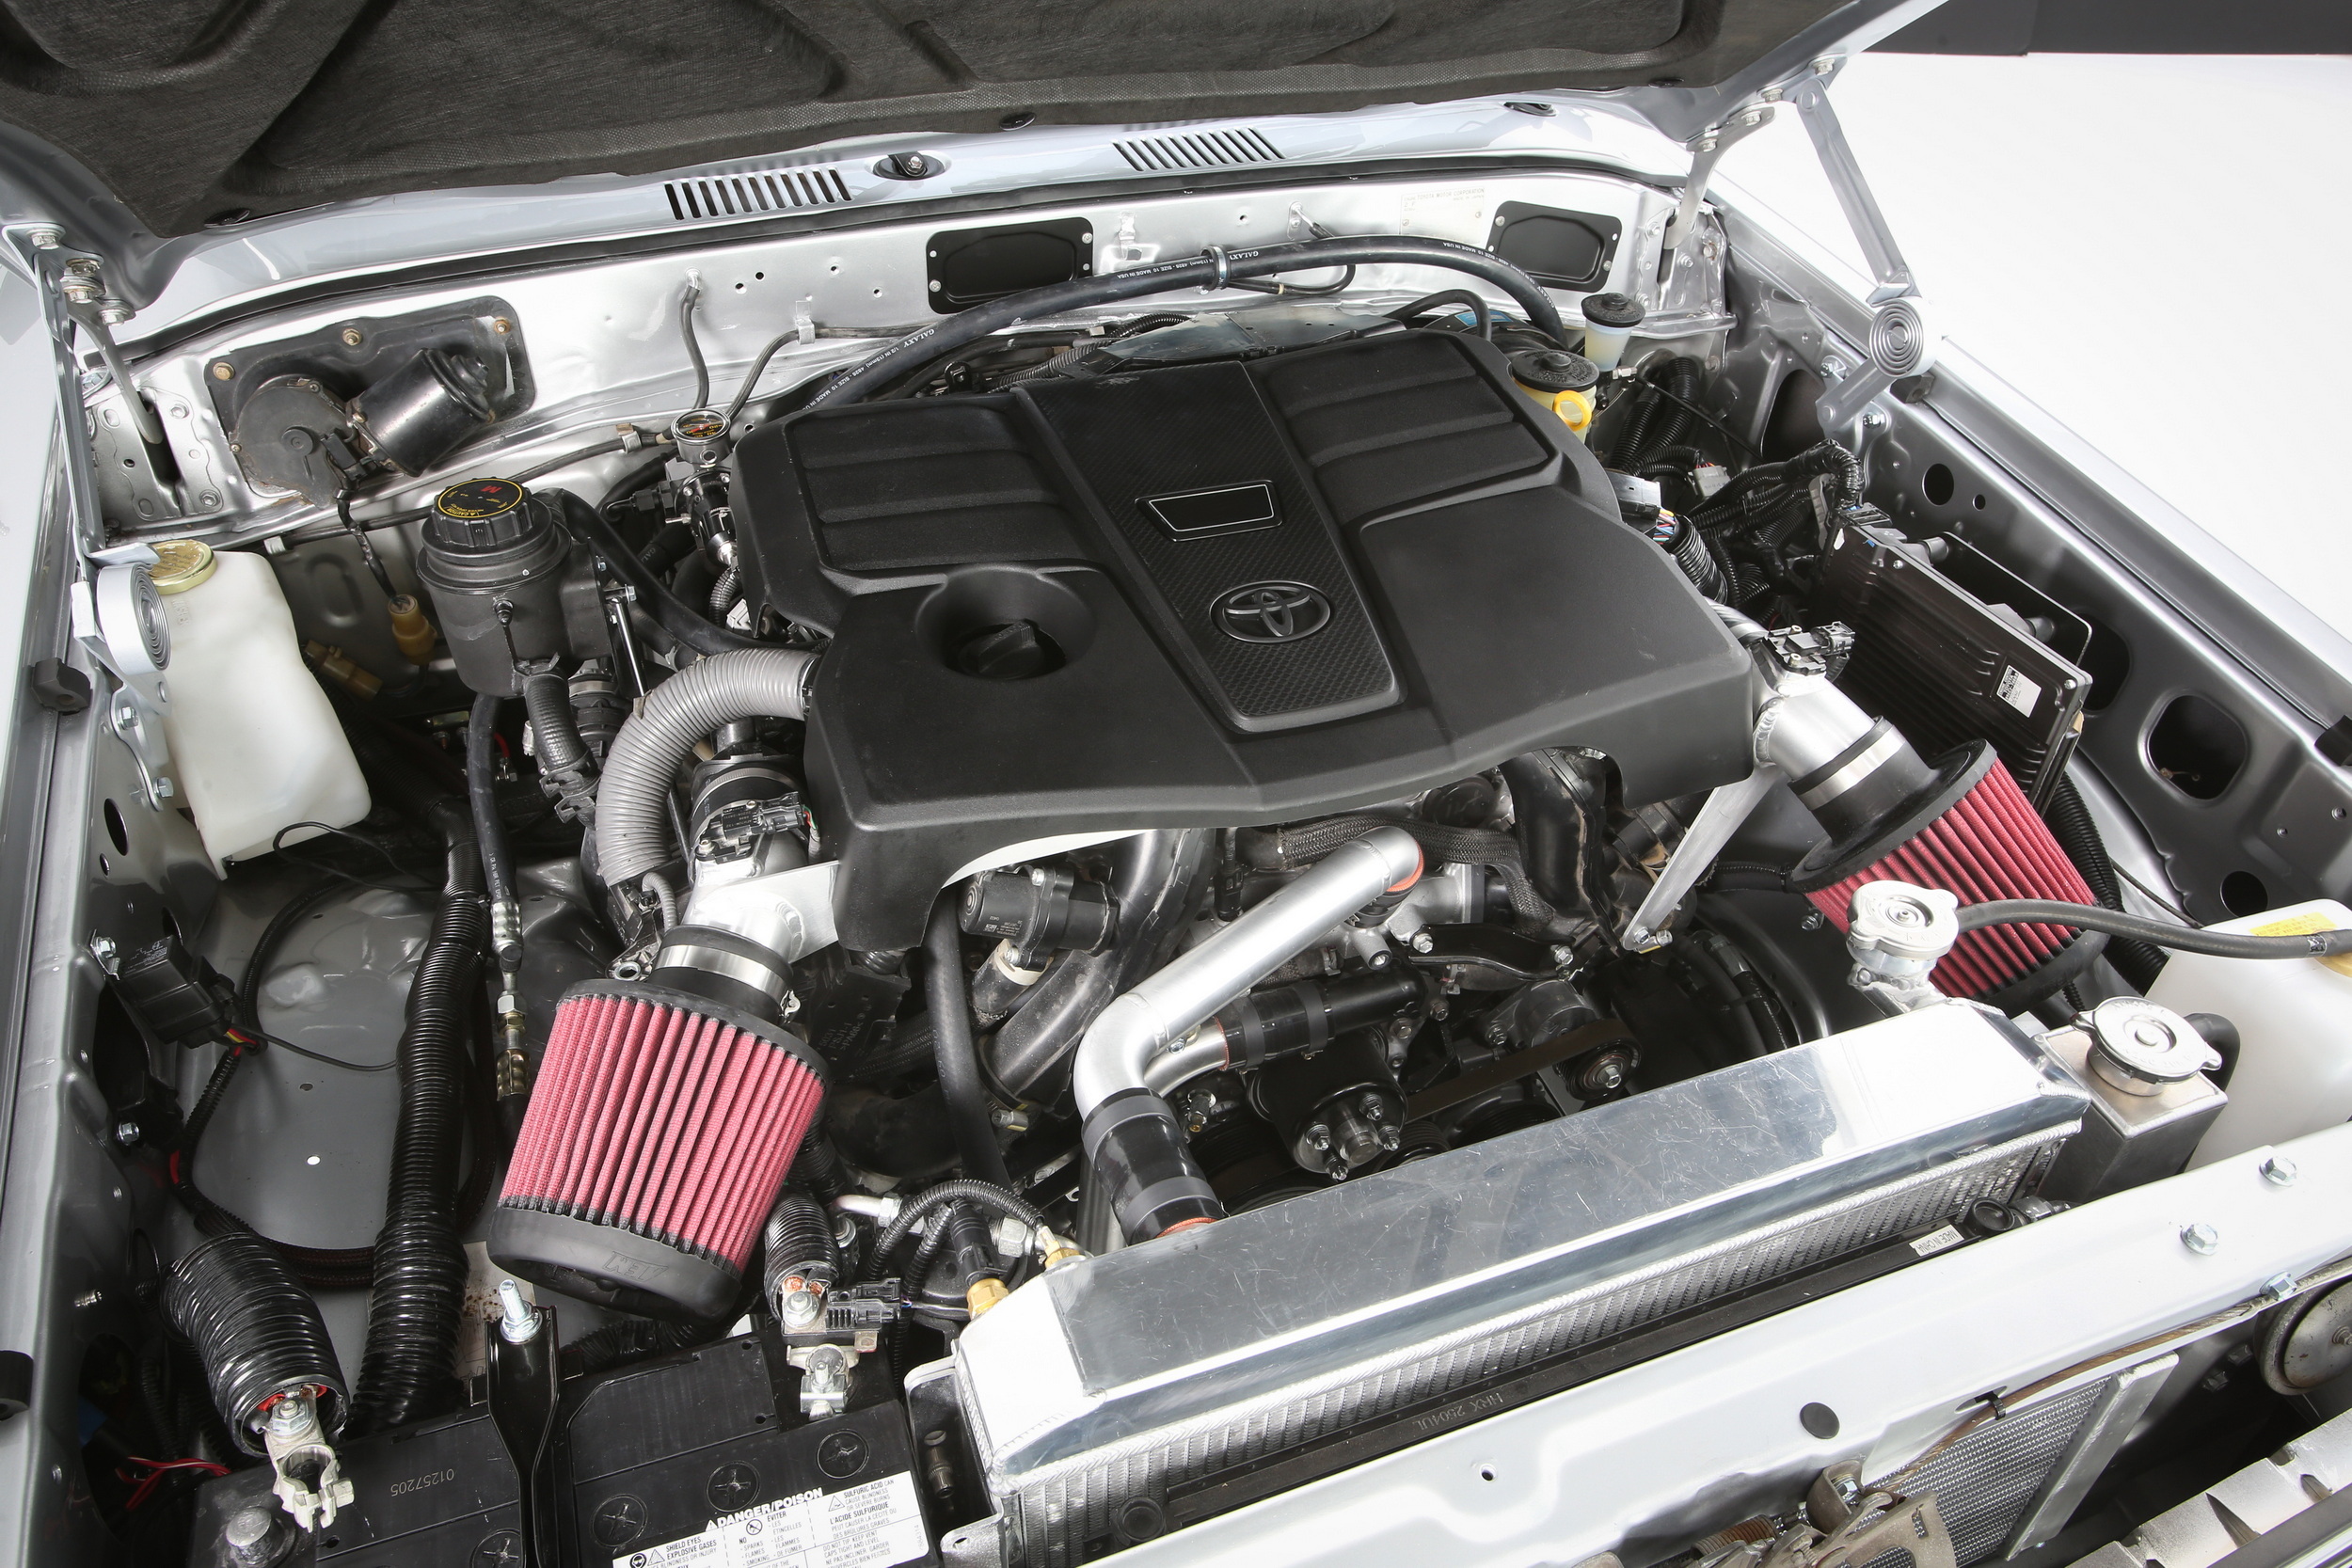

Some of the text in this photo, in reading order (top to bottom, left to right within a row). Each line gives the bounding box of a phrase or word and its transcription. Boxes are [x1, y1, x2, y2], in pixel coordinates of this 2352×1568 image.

[1485, 251, 1496, 260] SIZE
[904, 329, 935, 348] GALAXY
[866, 354, 884, 369] (13mm)
[838, 376, 850, 386] SIZE
[817, 389, 831, 403] MADE
[1915, 1229, 1958, 1253] MADE IN CHINA
[1469, 1392, 1504, 1413] HRX
[390, 1468, 454, 1497] 01257205
[844, 1485, 869, 1498] SULFURIC
[870, 1481, 882, 1490] ACID
[862, 1488, 888, 1499] BLINDNESS
[717, 1487, 823, 1528] DANGER/POISON
[855, 1499, 872, 1509] SEVERE
[874, 1495, 890, 1503] BURNS
[767, 1511, 787, 1522] EVITER
[830, 1501, 889, 1525] L'ACIDE SULFURIQUE
[773, 1522, 802, 1534] ETINCELLES
[845, 1517, 864, 1528] CAUSER
[870, 1519, 890, 1529] GRAVES
[666, 1536, 702, 1552] SHIELD EYES
[743, 1541, 764, 1551] SPARKS
[775, 1537, 800, 1549] FLAMMES
[832, 1541, 841, 1549] NOT
[852, 1534, 864, 1543] KEEP
[866, 1530, 878, 1539] VENT
[667, 1540, 717, 1560] EXPLOSIVE GASES
[745, 1548, 765, 1559] FLAMES
[785, 1544, 803, 1555] FUMER
[824, 1537, 879, 1559] CAPS TIGHT AND LEVEL
[844, 1548, 866, 1560] INCLINER
[869, 1541, 890, 1552] GARDER
[660, 1557, 690, 1568] BLINDNESS
[698, 1548, 717, 1559] INJURY
[746, 1555, 770, 1566] SMOKING
[828, 1557, 859, 1568] UVERCLES
[860, 1553, 870, 1561] BIEN
